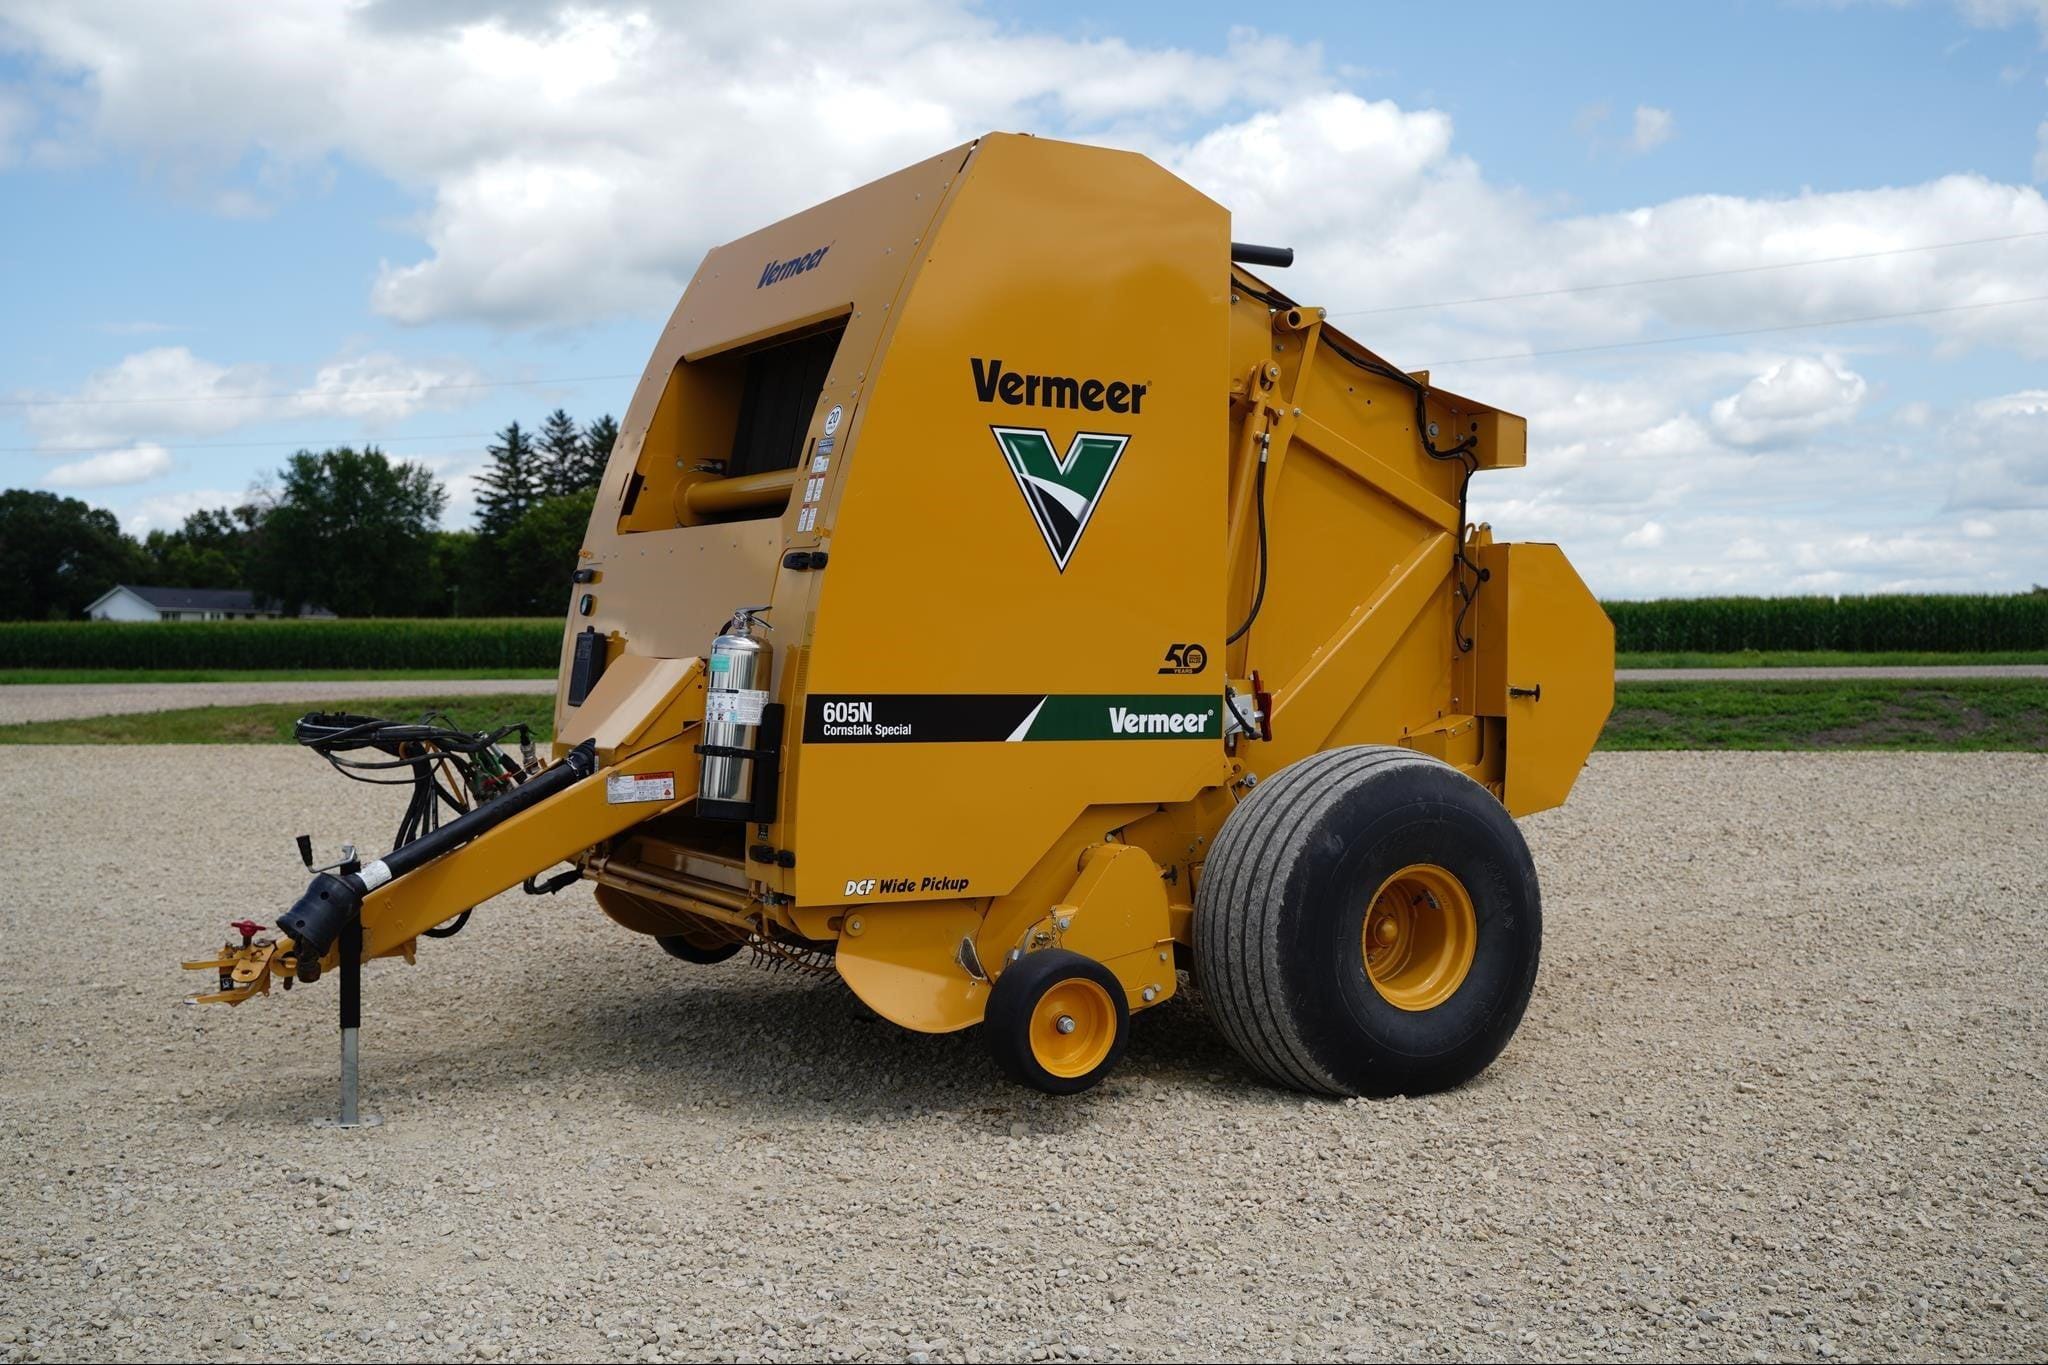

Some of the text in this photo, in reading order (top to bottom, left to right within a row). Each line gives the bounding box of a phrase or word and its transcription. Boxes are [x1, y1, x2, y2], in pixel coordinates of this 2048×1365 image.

[756, 245, 830, 289] Vermeer
[970, 357, 1147, 414] Vermeer
[828, 410, 839, 424] 20
[1164, 643, 1208, 674] 50
[822, 701, 873, 723] 605N
[1108, 707, 1208, 733] Vermeer
[823, 723, 912, 738] Cornstalk Special
[844, 876, 969, 896] DCF Wide Pickup
